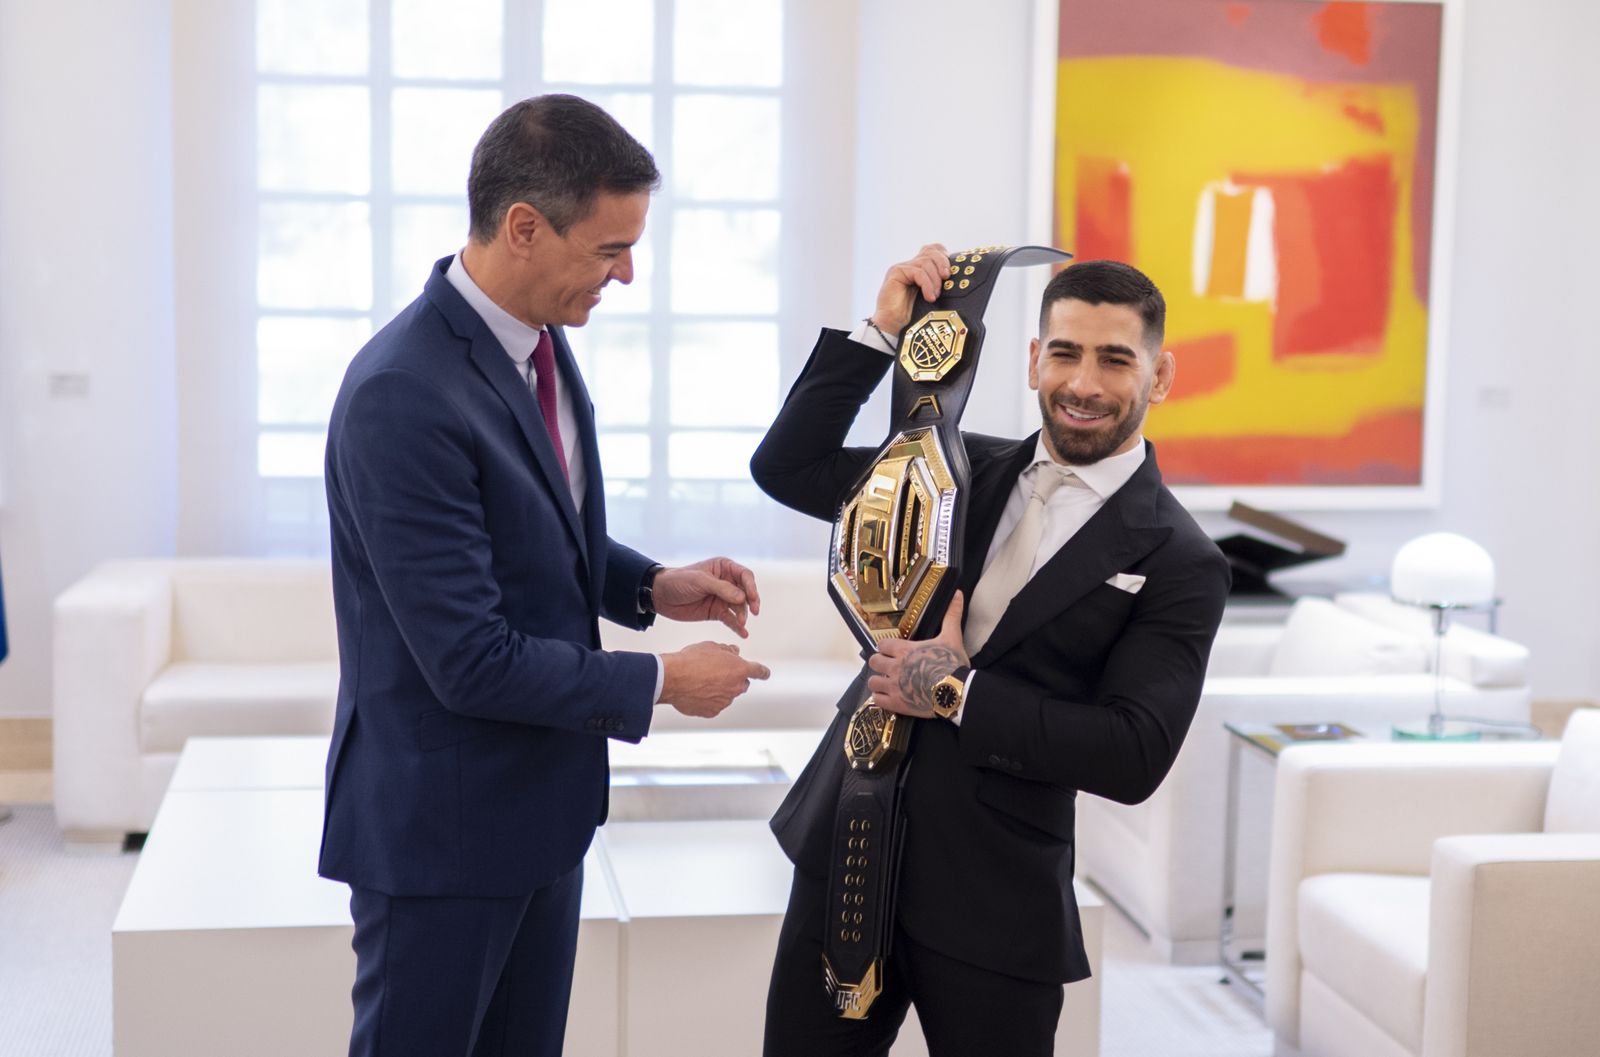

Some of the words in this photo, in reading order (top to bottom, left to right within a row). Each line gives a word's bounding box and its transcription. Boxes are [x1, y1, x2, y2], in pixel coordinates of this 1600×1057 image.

[919, 328, 944, 363] CHAMPION
[926, 326, 947, 355] WORLD
[858, 472, 898, 592] UFC
[835, 990, 862, 1012] UFC
